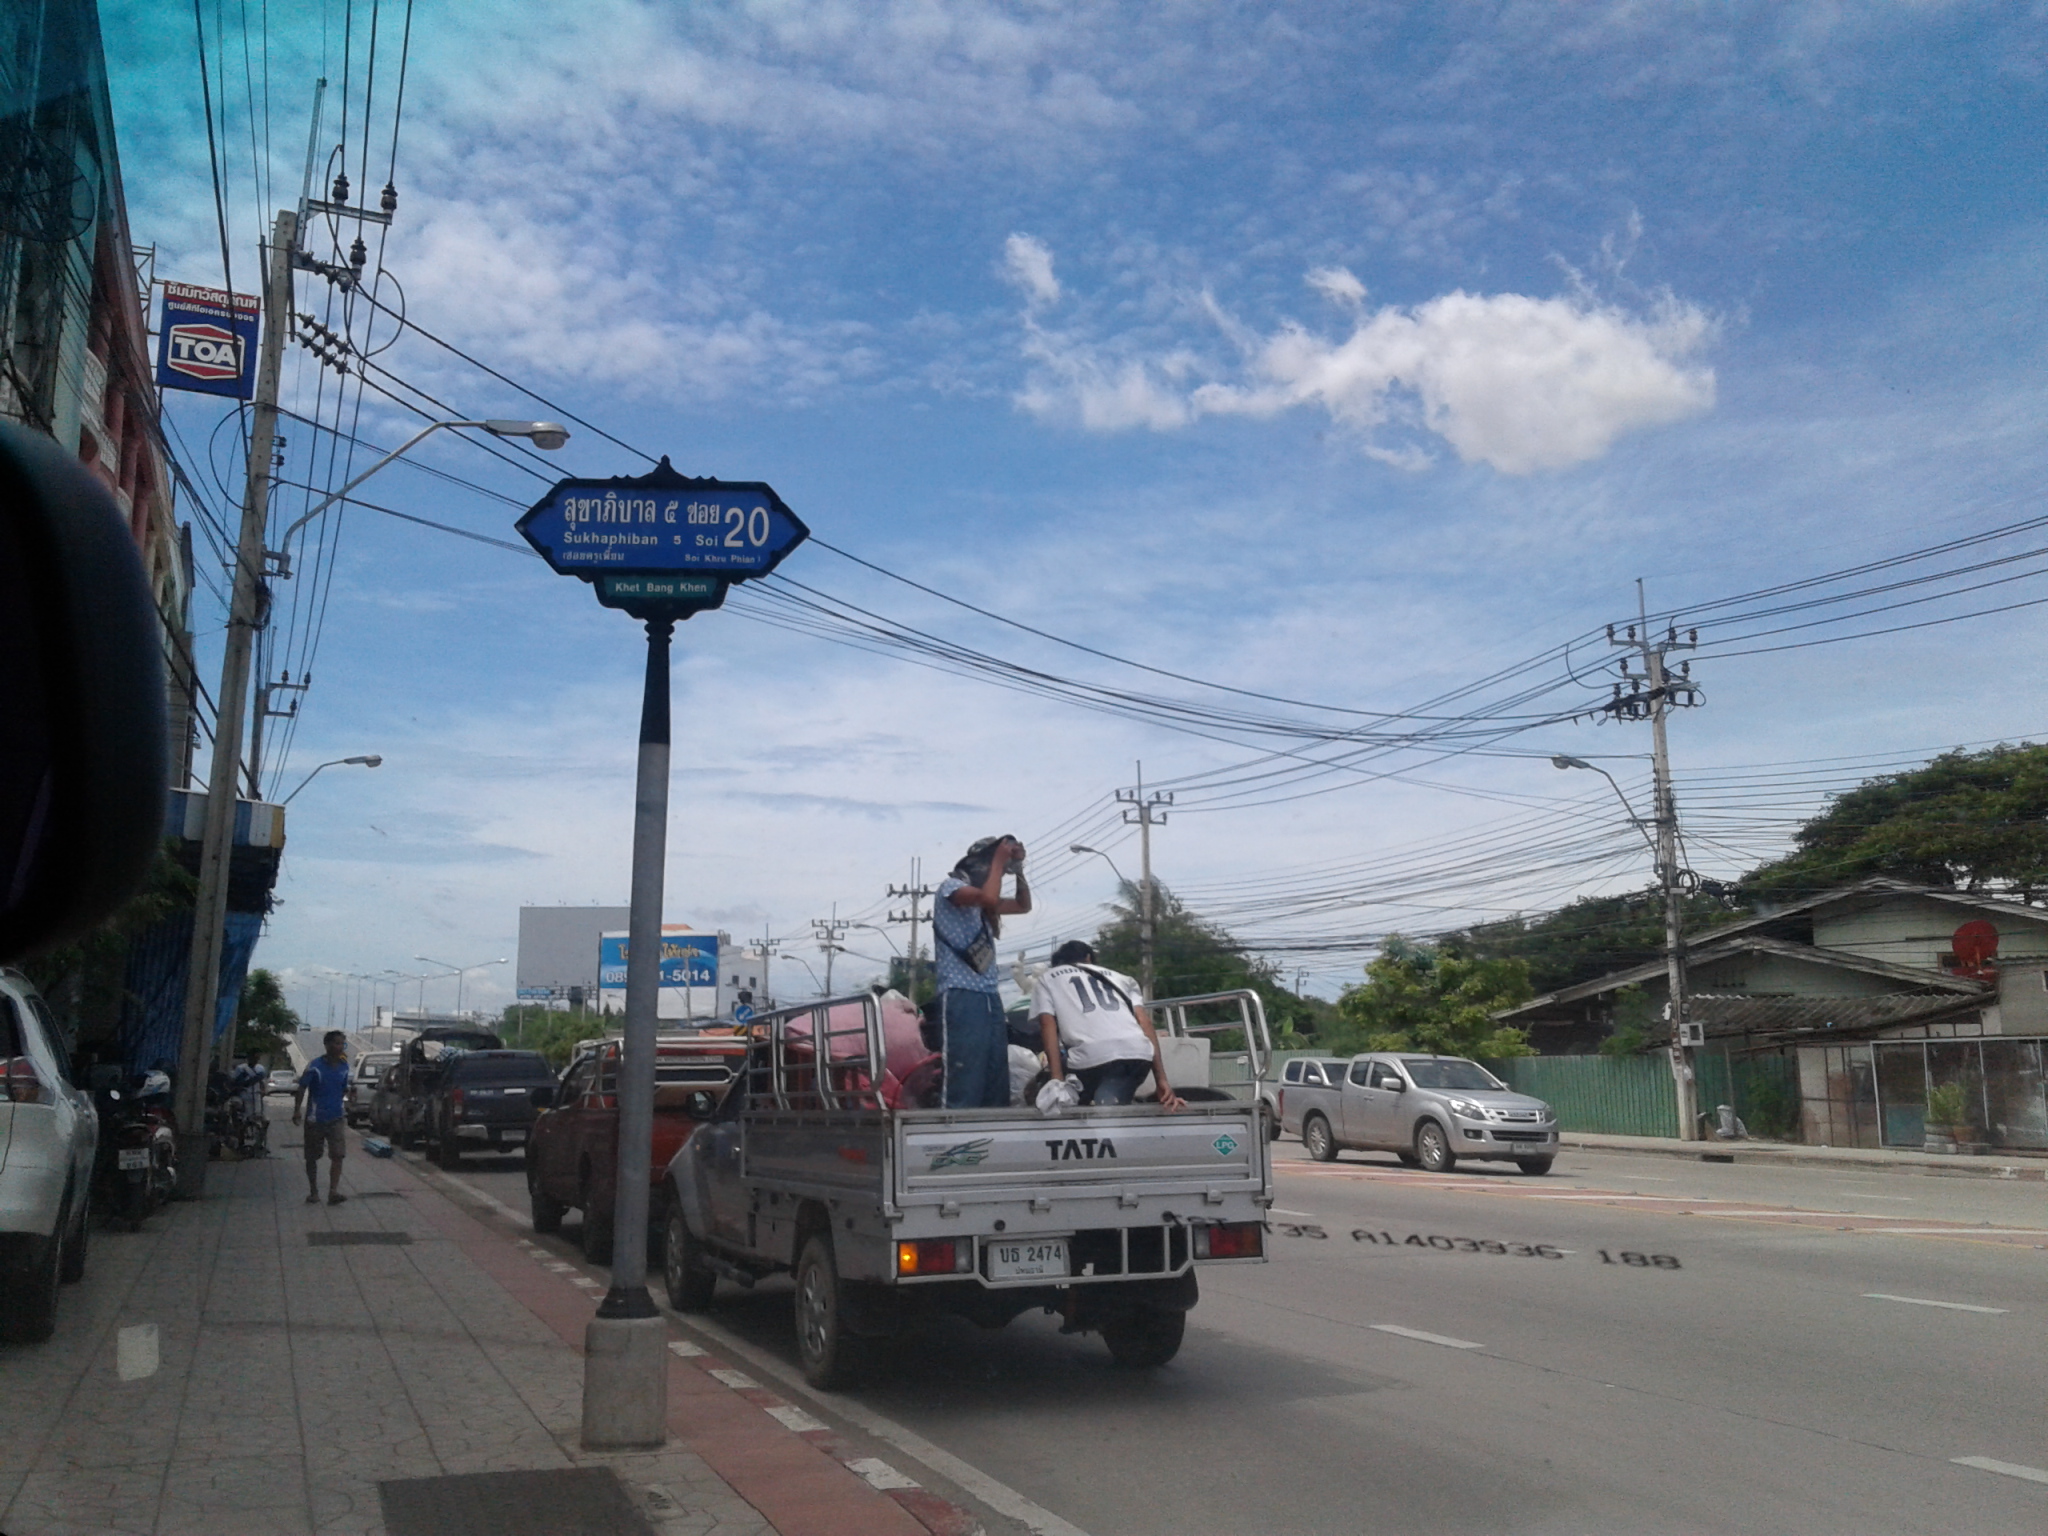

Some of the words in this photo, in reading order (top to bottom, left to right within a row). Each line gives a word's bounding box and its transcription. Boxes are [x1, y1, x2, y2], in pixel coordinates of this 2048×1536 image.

[174, 336, 237, 366] TOA
[564, 490, 656, 531] สุขาภิบาล
[664, 500, 679, 524] ๕
[687, 503, 720, 525] ซอย
[723, 506, 770, 548] 20
[564, 532, 658, 547] Sukhaphiban
[673, 536, 681, 545] 5
[695, 535, 719, 547] Soi
[615, 582, 640, 593] Khet
[647, 582, 674, 595] Bang
[680, 582, 707, 593] Khen
[1069, 976, 1120, 1014] 10
[1045, 1138, 1117, 1161] TATA
[1024, 1245, 1061, 1262] 2474
[1350, 1228, 1564, 1261] A1403936
[1597, 1249, 1682, 1271] 188
